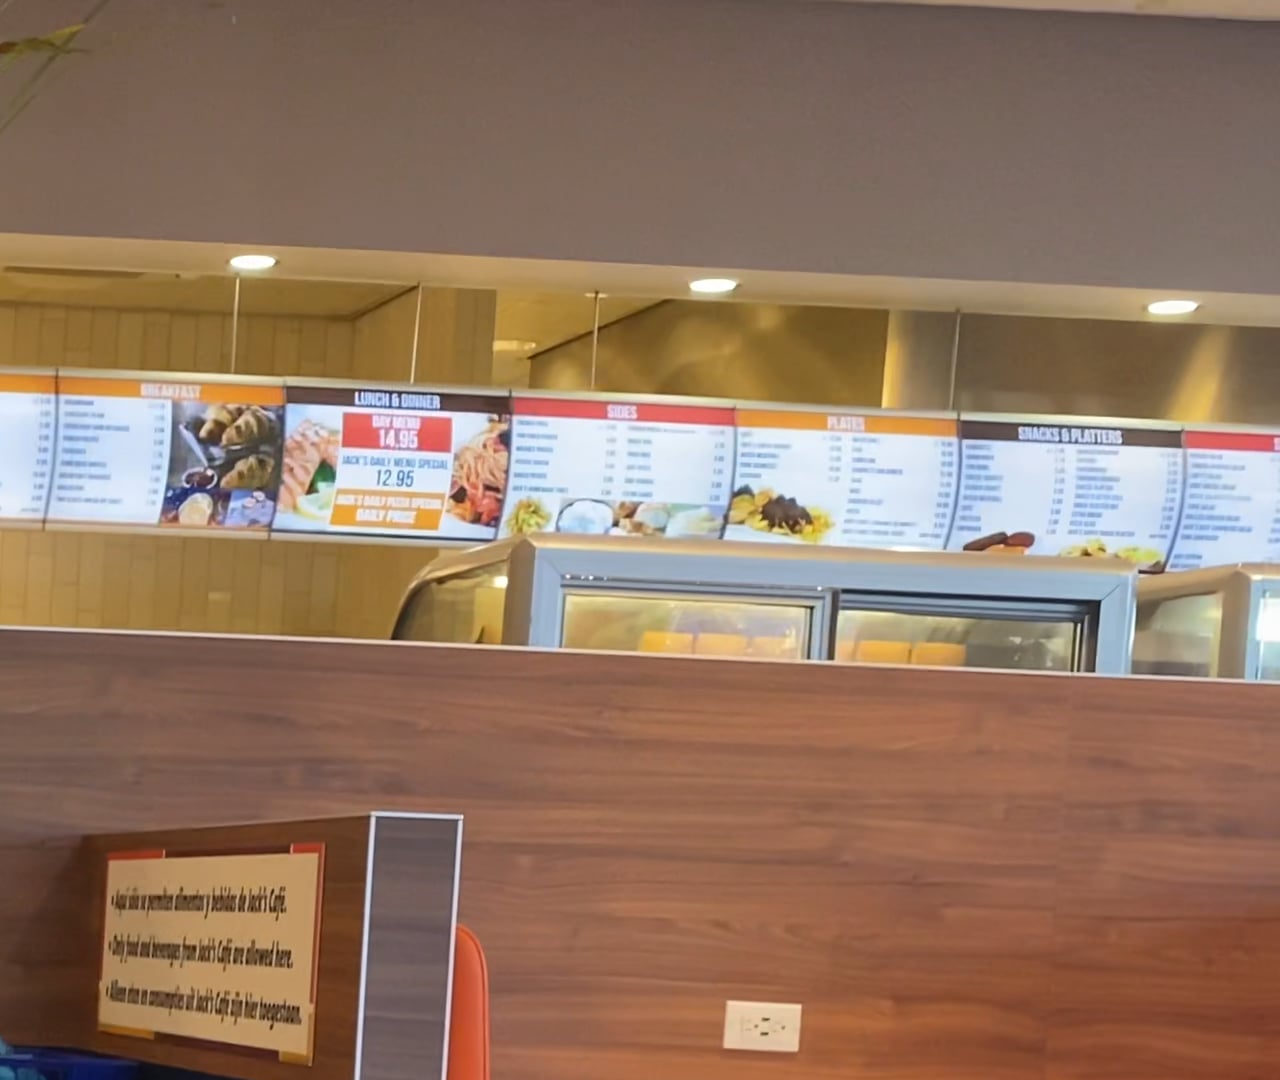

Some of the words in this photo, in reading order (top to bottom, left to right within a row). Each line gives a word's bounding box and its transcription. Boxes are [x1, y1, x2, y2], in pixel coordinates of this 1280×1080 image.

[354, 391, 390, 407] LUNCH
[401, 393, 441, 409] DINNER
[607, 404, 638, 419] SIDES
[378, 428, 419, 449] 14.95
[1018, 426, 1060, 442] SNACKS
[1070, 428, 1123, 445] PLATTERS
[376, 469, 415, 488] 12.95
[245, 938, 275, 968] allowed
